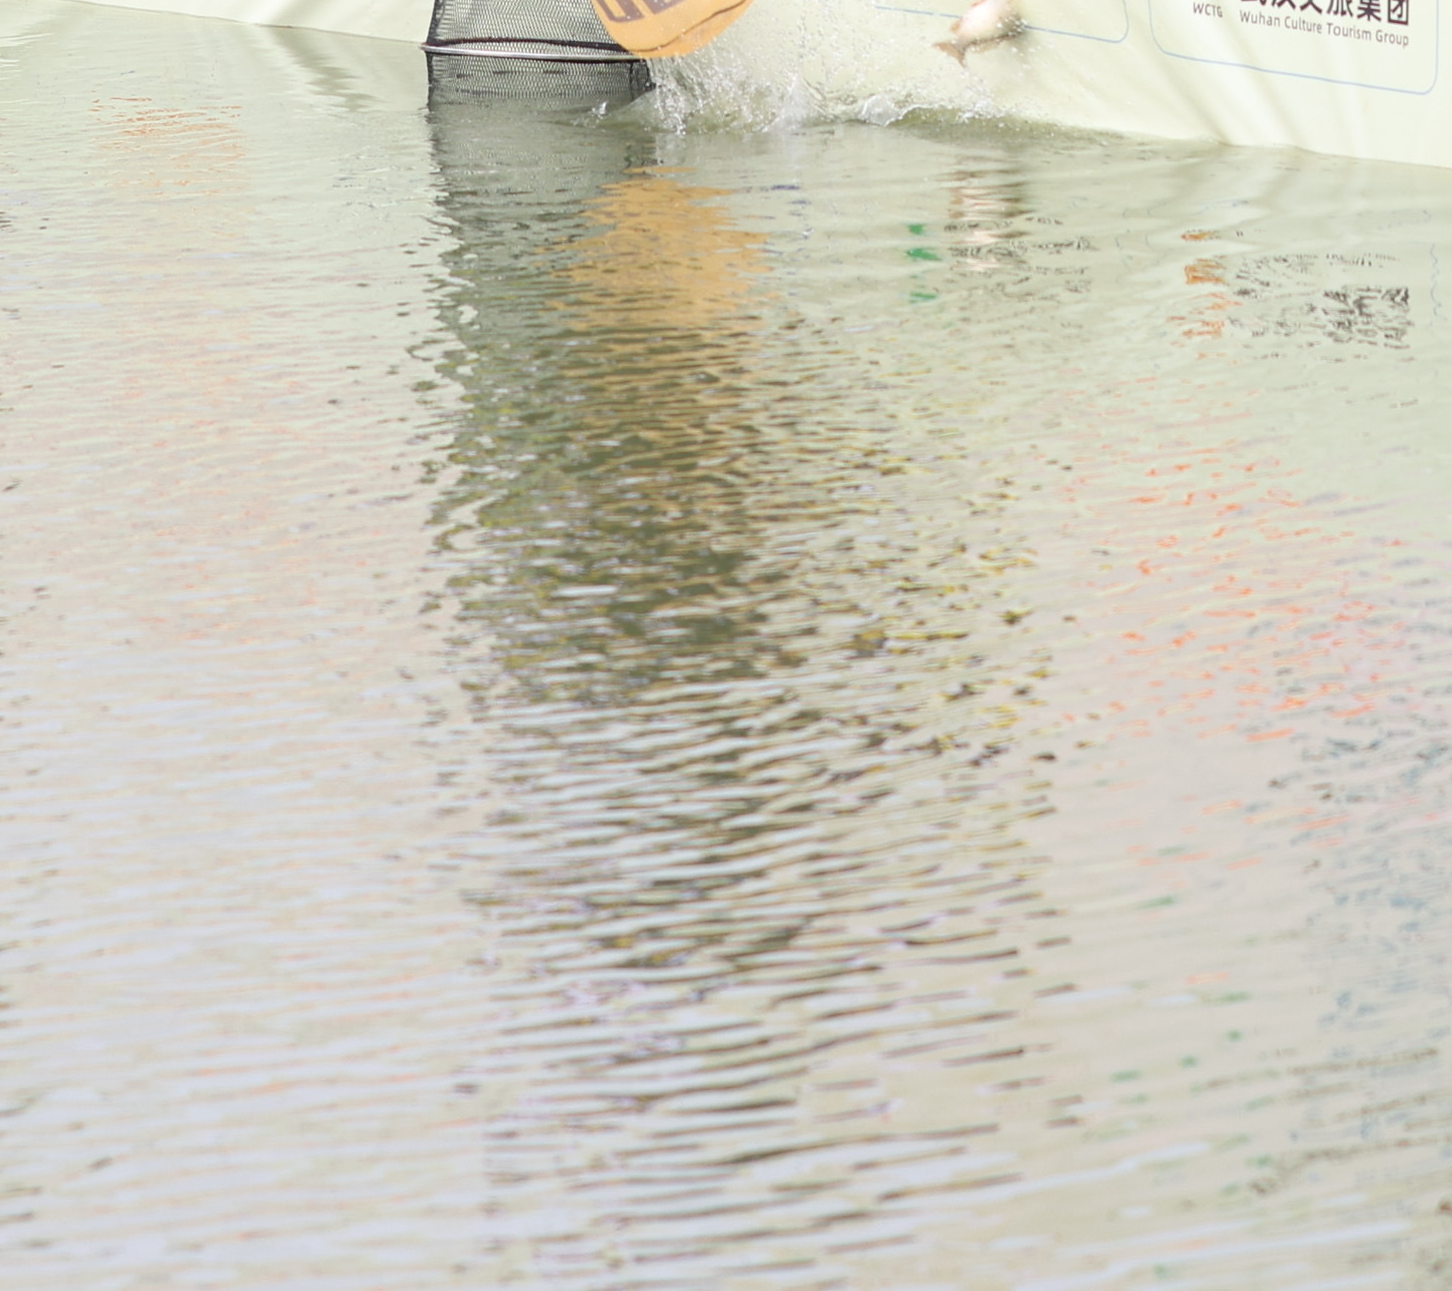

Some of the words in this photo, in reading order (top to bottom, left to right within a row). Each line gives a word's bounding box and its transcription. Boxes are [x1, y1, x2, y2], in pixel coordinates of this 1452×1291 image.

[1193, 3, 1223, 18] WCTG
[1240, 10, 1280, 27] Wuhan
[1284, 14, 1322, 34] Culture
[1326, 21, 1371, 40] Tourism
[1375, 29, 1409, 48] Group
